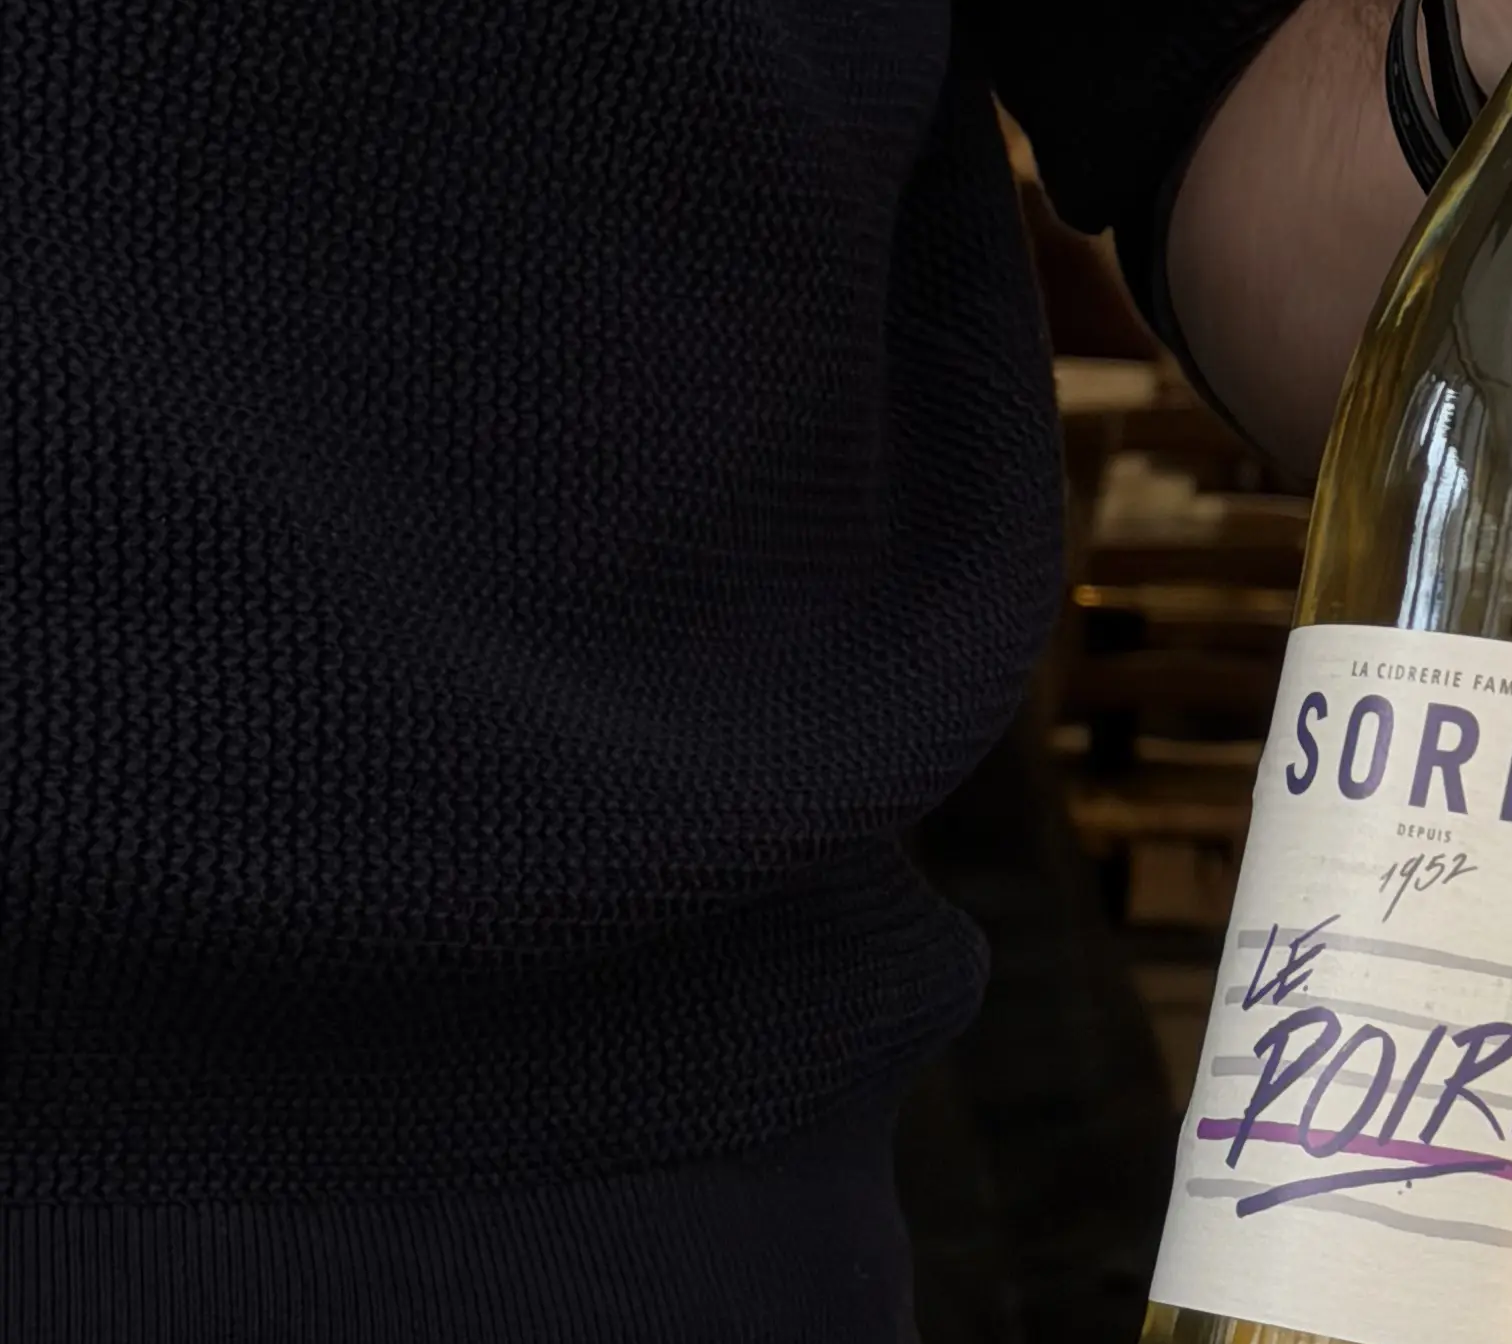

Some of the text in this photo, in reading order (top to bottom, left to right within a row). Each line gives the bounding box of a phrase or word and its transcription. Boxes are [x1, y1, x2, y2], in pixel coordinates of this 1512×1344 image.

[1350, 659, 1372, 679] LA
[1376, 662, 1464, 689] CIDRERIE
[1396, 822, 1453, 844] DEPUIS
[1379, 853, 1479, 924] 1952
